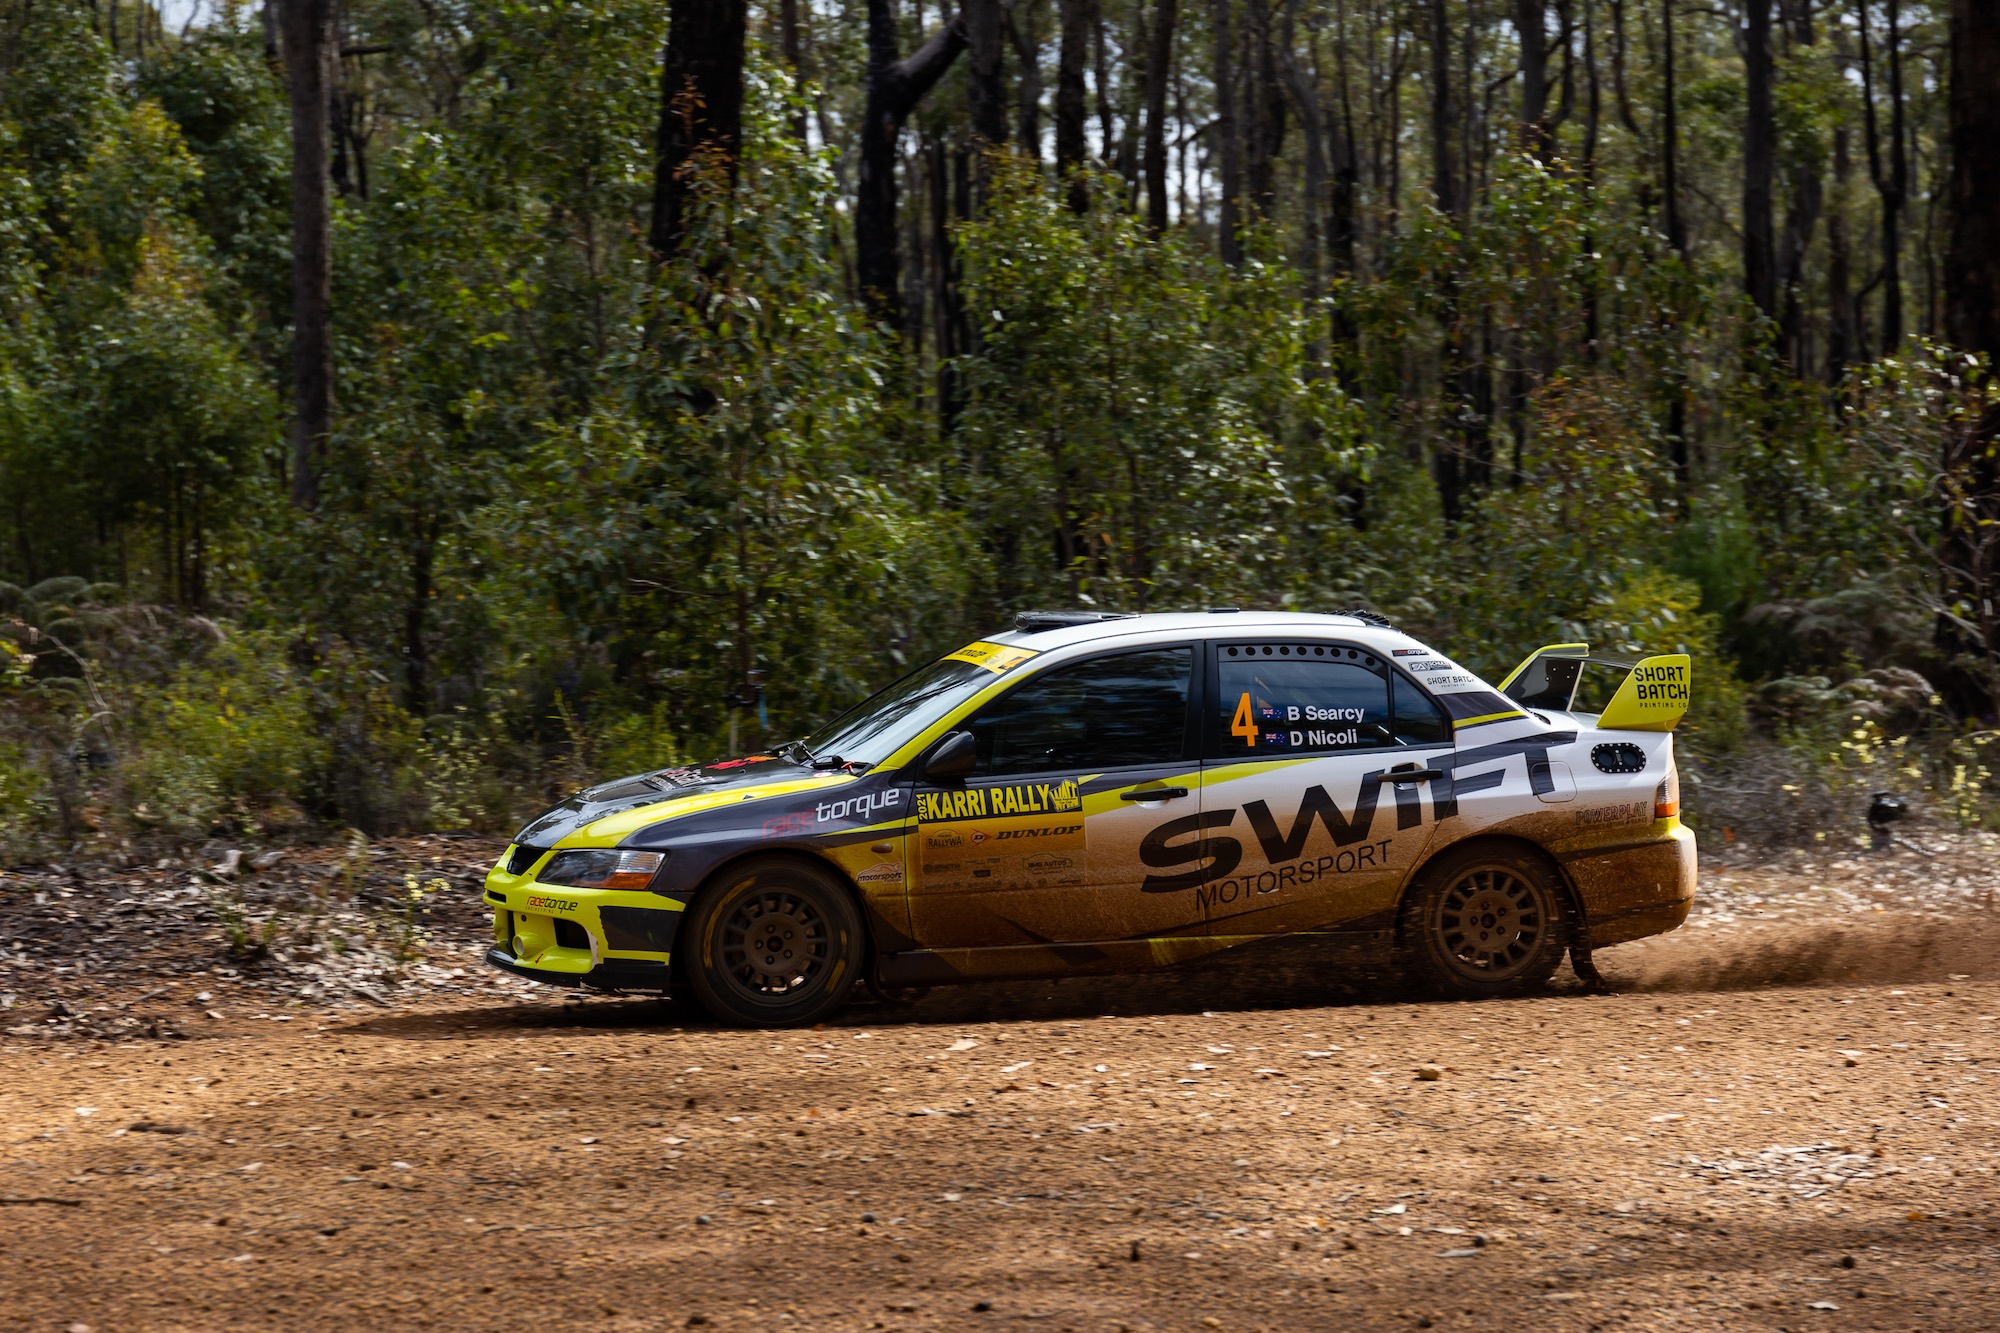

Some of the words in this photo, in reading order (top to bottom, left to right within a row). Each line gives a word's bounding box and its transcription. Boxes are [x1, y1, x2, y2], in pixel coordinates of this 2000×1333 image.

[1427, 676, 1451, 685] SHORT
[1453, 675, 1474, 684] BATC
[1634, 666, 1684, 682] SHORT
[1637, 683, 1688, 700] BATCH
[1231, 692, 1259, 747] 4
[1287, 706, 1300, 721] B
[1305, 705, 1365, 724] Searcy
[1290, 730, 1303, 746] D
[1308, 729, 1358, 746] Nicoli
[916, 793, 928, 821] 2021
[925, 788, 987, 820] KARRI
[990, 783, 1050, 815] RALLY
[1139, 731, 1578, 893] SWIFT
[1575, 801, 1648, 826] POWERPLAY
[995, 825, 1084, 841] DUNLOP
[1196, 839, 1393, 911] MOTORSPORT
